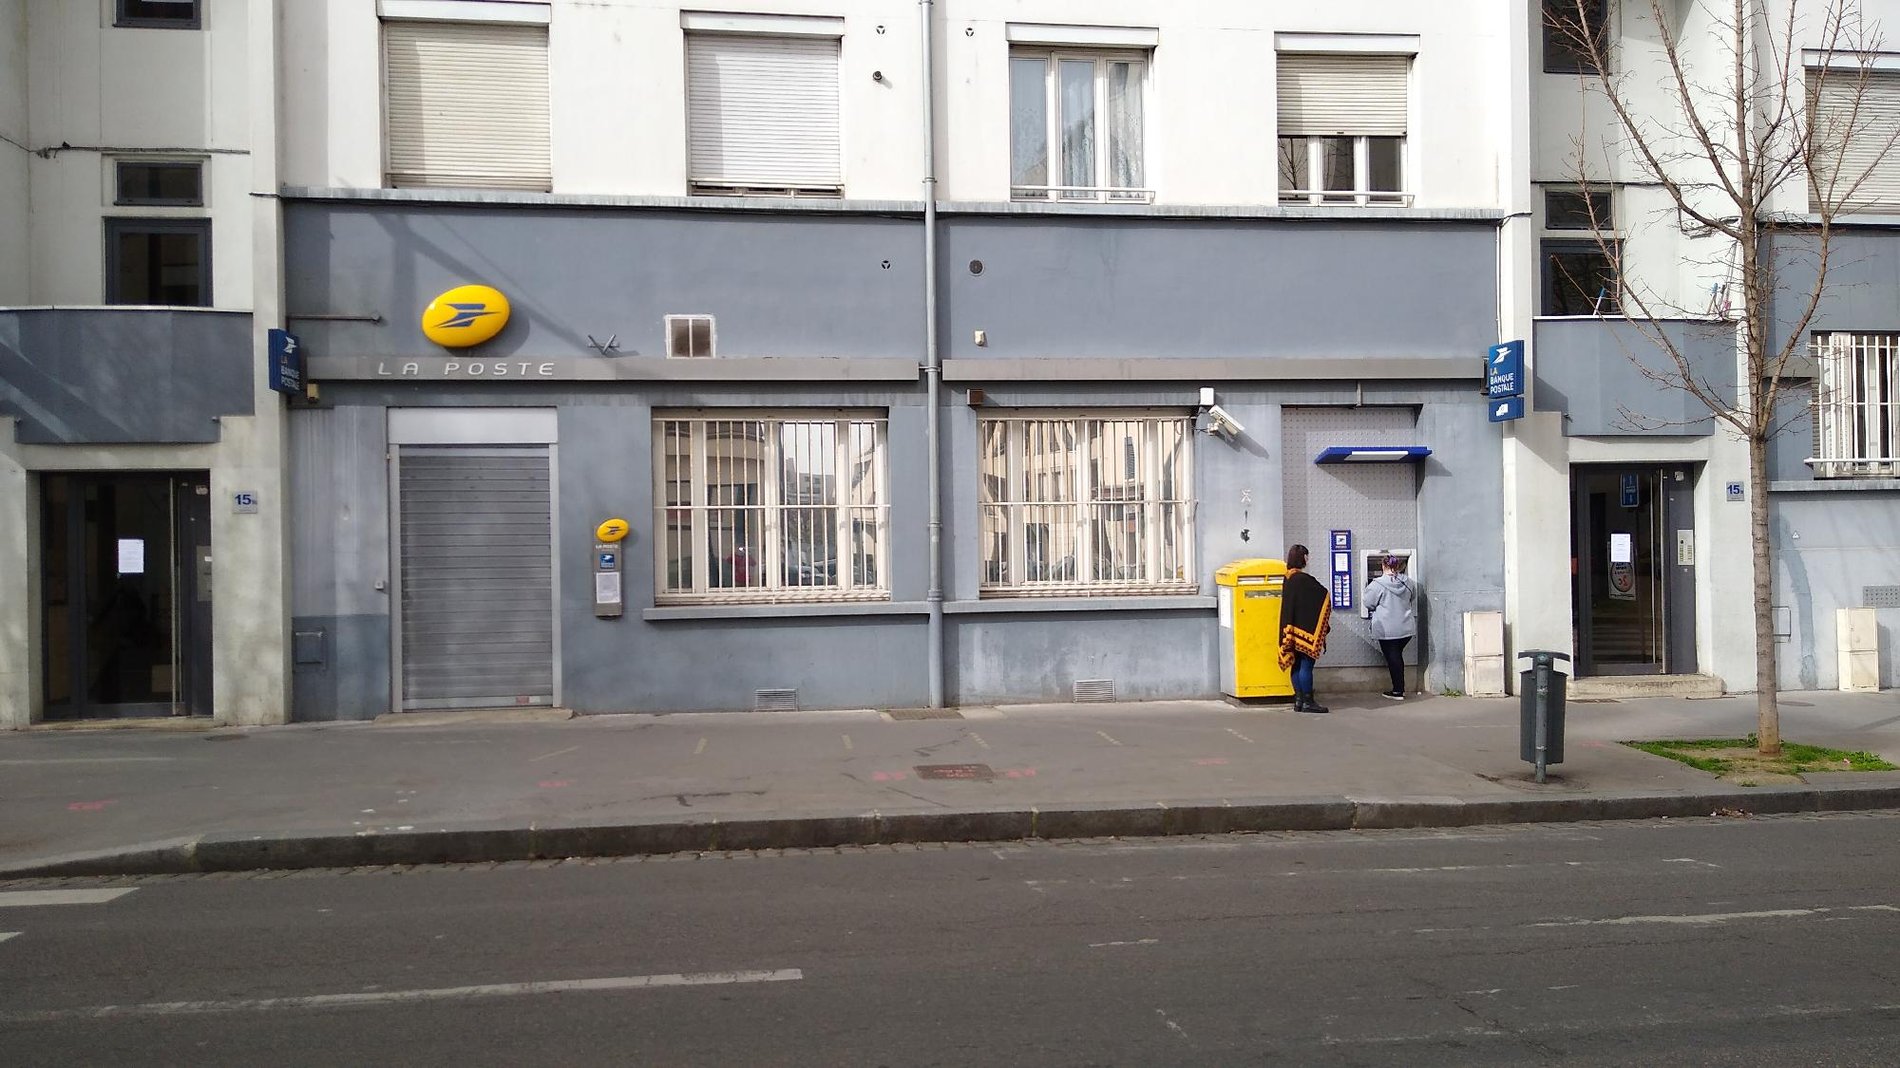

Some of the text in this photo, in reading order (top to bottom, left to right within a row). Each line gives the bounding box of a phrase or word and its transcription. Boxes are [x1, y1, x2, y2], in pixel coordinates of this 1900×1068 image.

[378, 361, 556, 376] LA POSTE
[1489, 367, 1498, 376] LA
[1489, 372, 1514, 385] BANQUE
[1489, 382, 1514, 394] POSTALE
